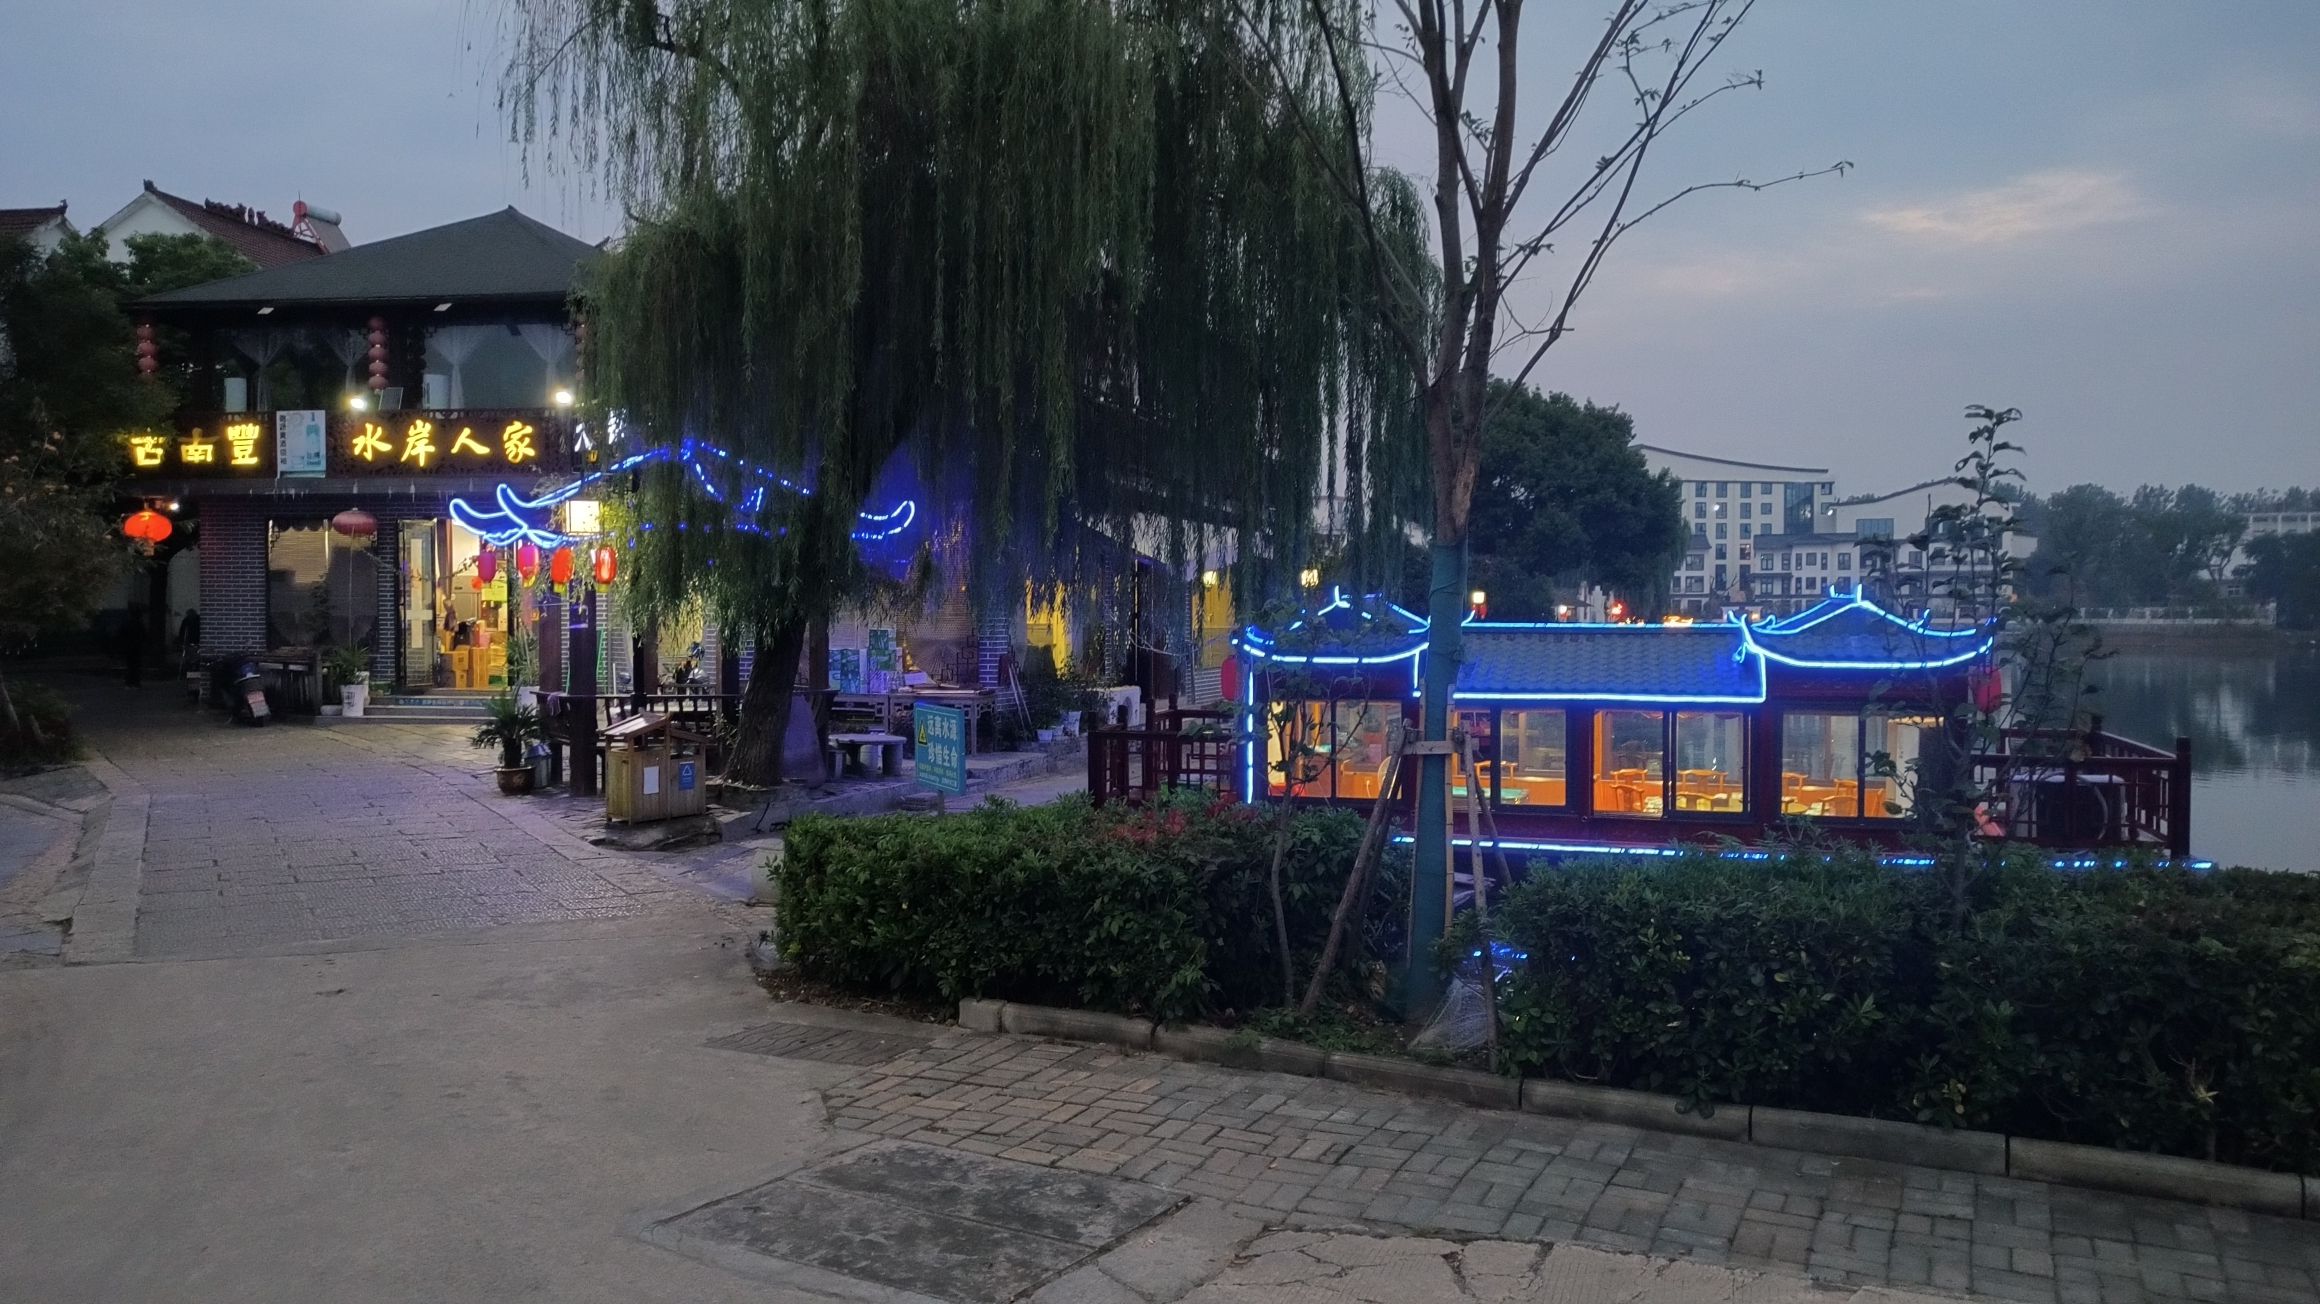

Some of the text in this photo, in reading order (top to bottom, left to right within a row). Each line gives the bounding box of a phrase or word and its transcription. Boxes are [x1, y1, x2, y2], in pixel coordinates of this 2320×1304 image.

[352, 419, 536, 467] 水岸人家
[927, 715, 957, 742] 远离水源
[928, 742, 958, 769] 珍惜生命
